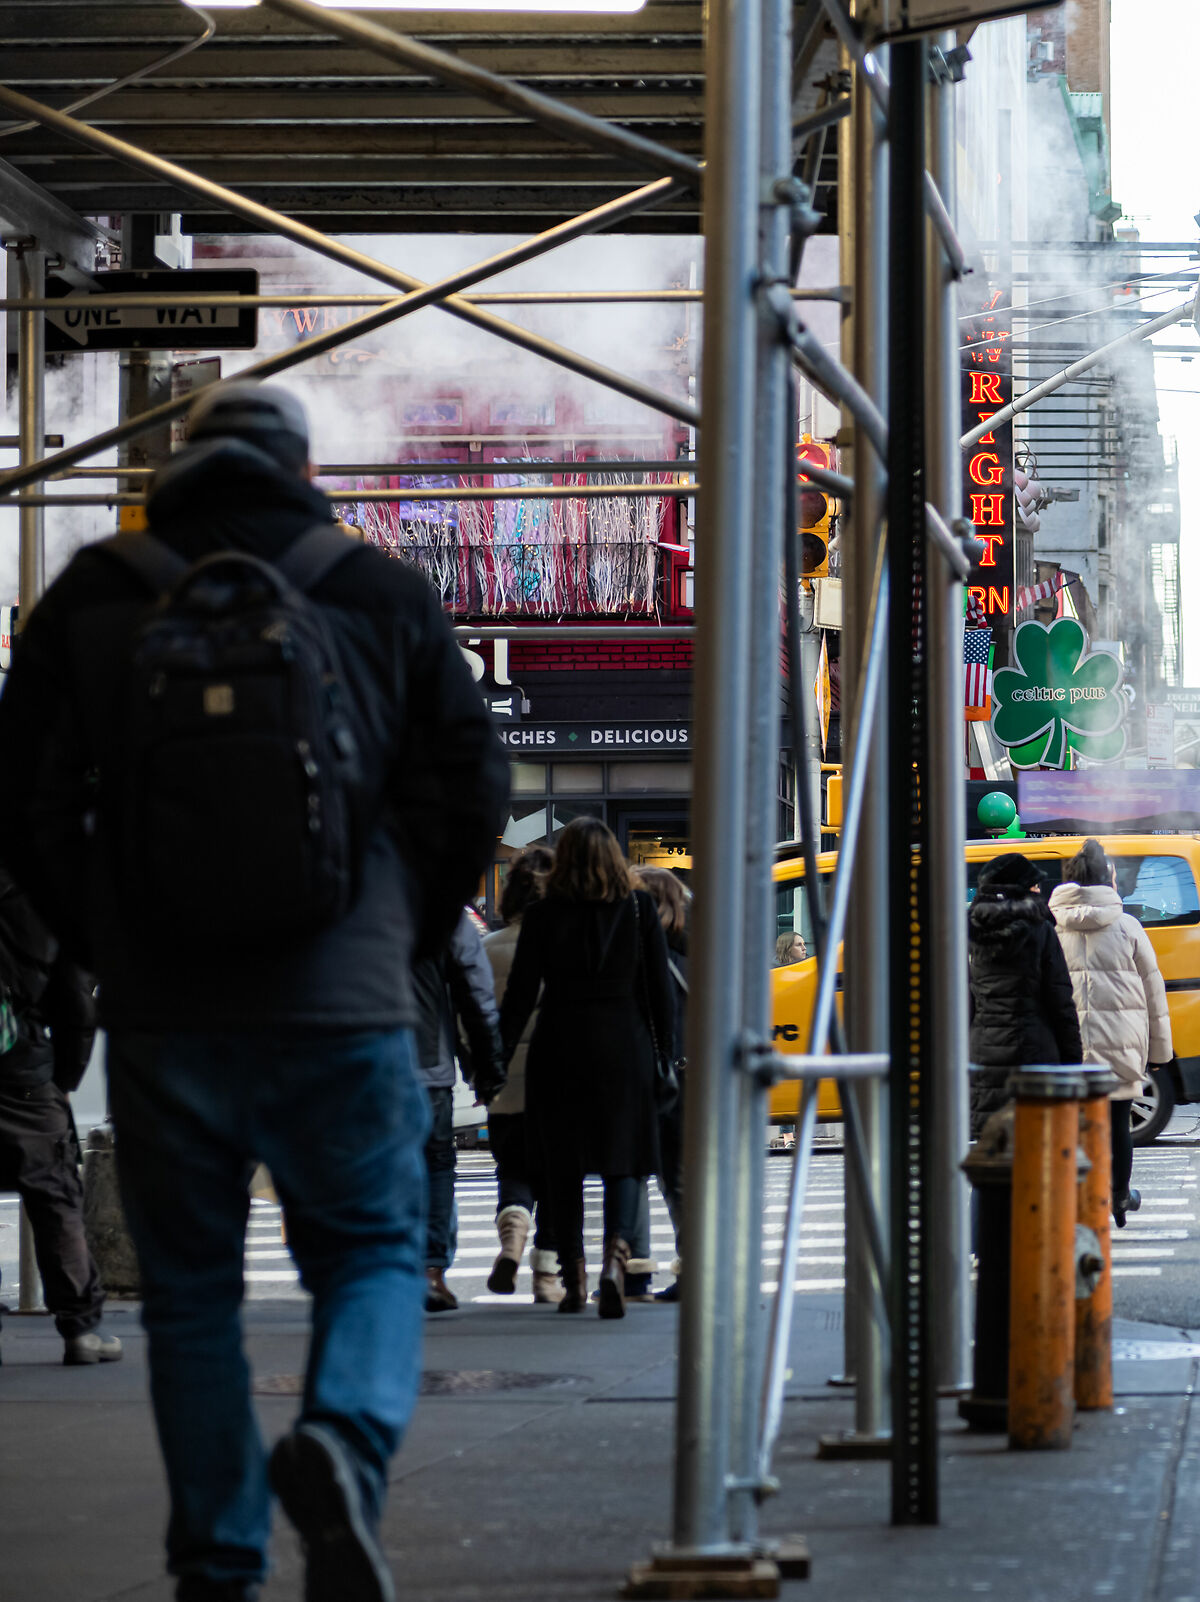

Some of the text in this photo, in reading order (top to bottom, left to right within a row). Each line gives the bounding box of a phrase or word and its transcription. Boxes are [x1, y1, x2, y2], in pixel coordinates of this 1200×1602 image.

[64, 304, 222, 328] ONE WAY
[591, 729, 688, 744] DELICIOUS
